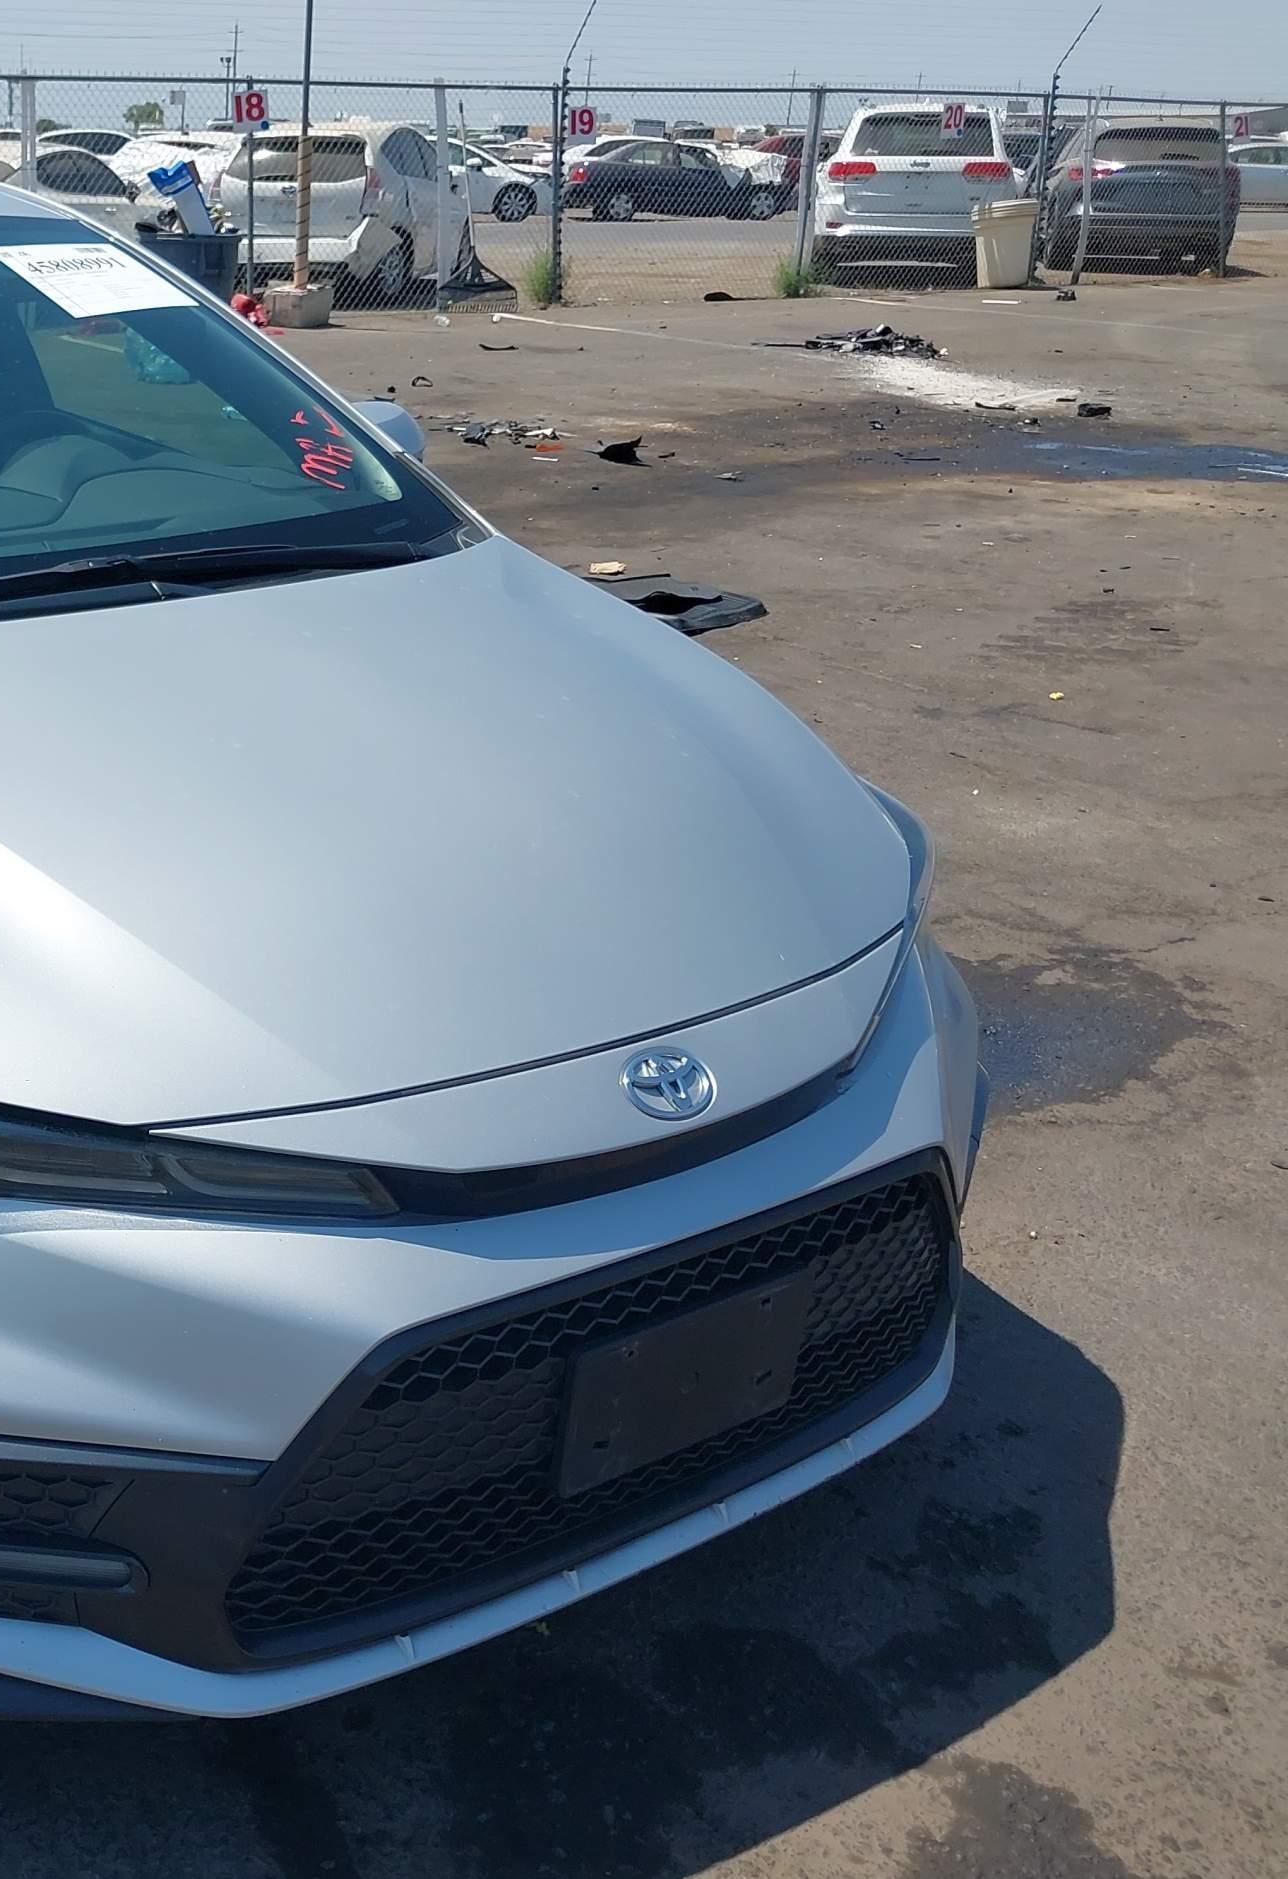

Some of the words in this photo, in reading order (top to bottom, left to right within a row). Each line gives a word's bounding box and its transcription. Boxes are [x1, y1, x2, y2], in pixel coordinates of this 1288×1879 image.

[234, 93, 265, 123] 18
[943, 104, 963, 129] 20
[570, 109, 594, 135] 19
[1234, 116, 1248, 137] 21
[27, 256, 127, 274] 45808991
